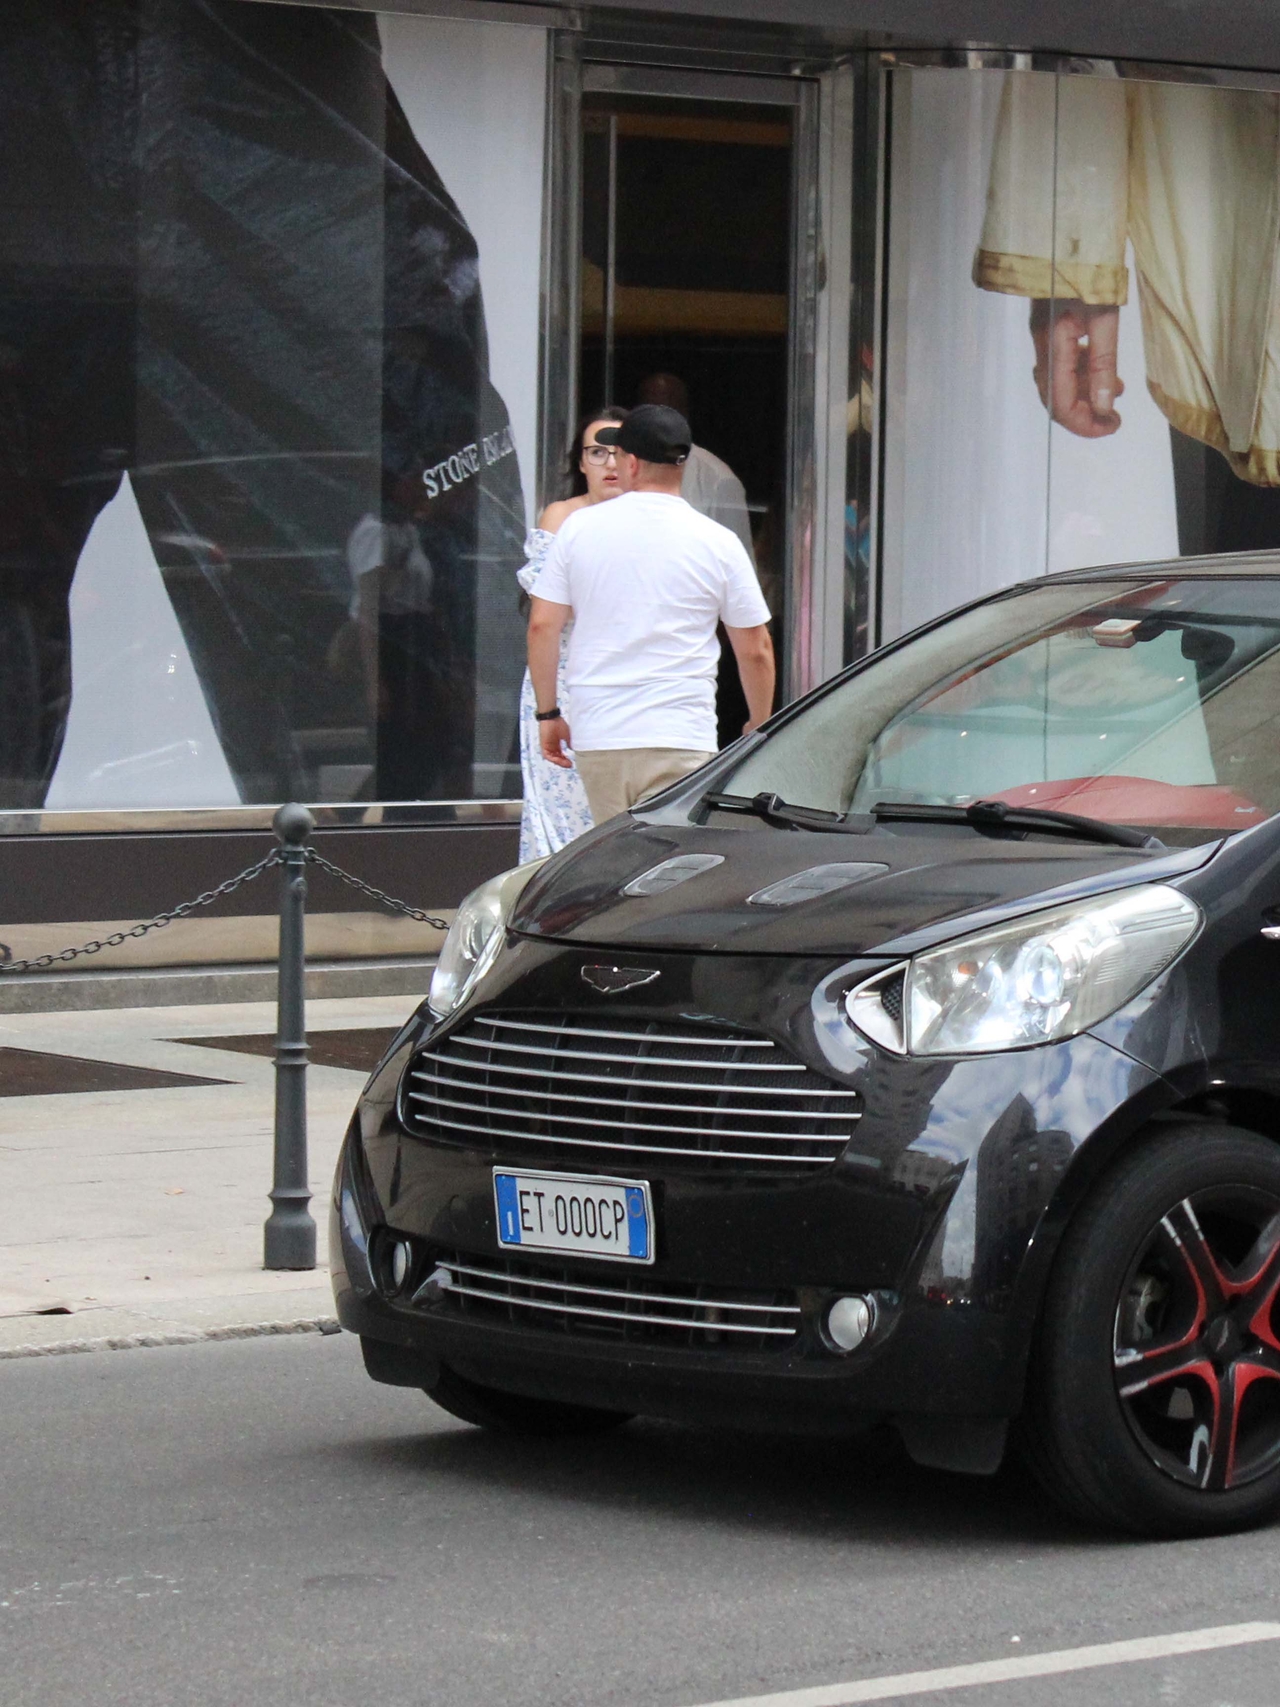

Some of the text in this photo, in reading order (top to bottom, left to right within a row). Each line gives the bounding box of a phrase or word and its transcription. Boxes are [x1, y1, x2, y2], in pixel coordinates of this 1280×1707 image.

[422, 443, 480, 499] STONE
[519, 1190, 625, 1241] ET 000CP
